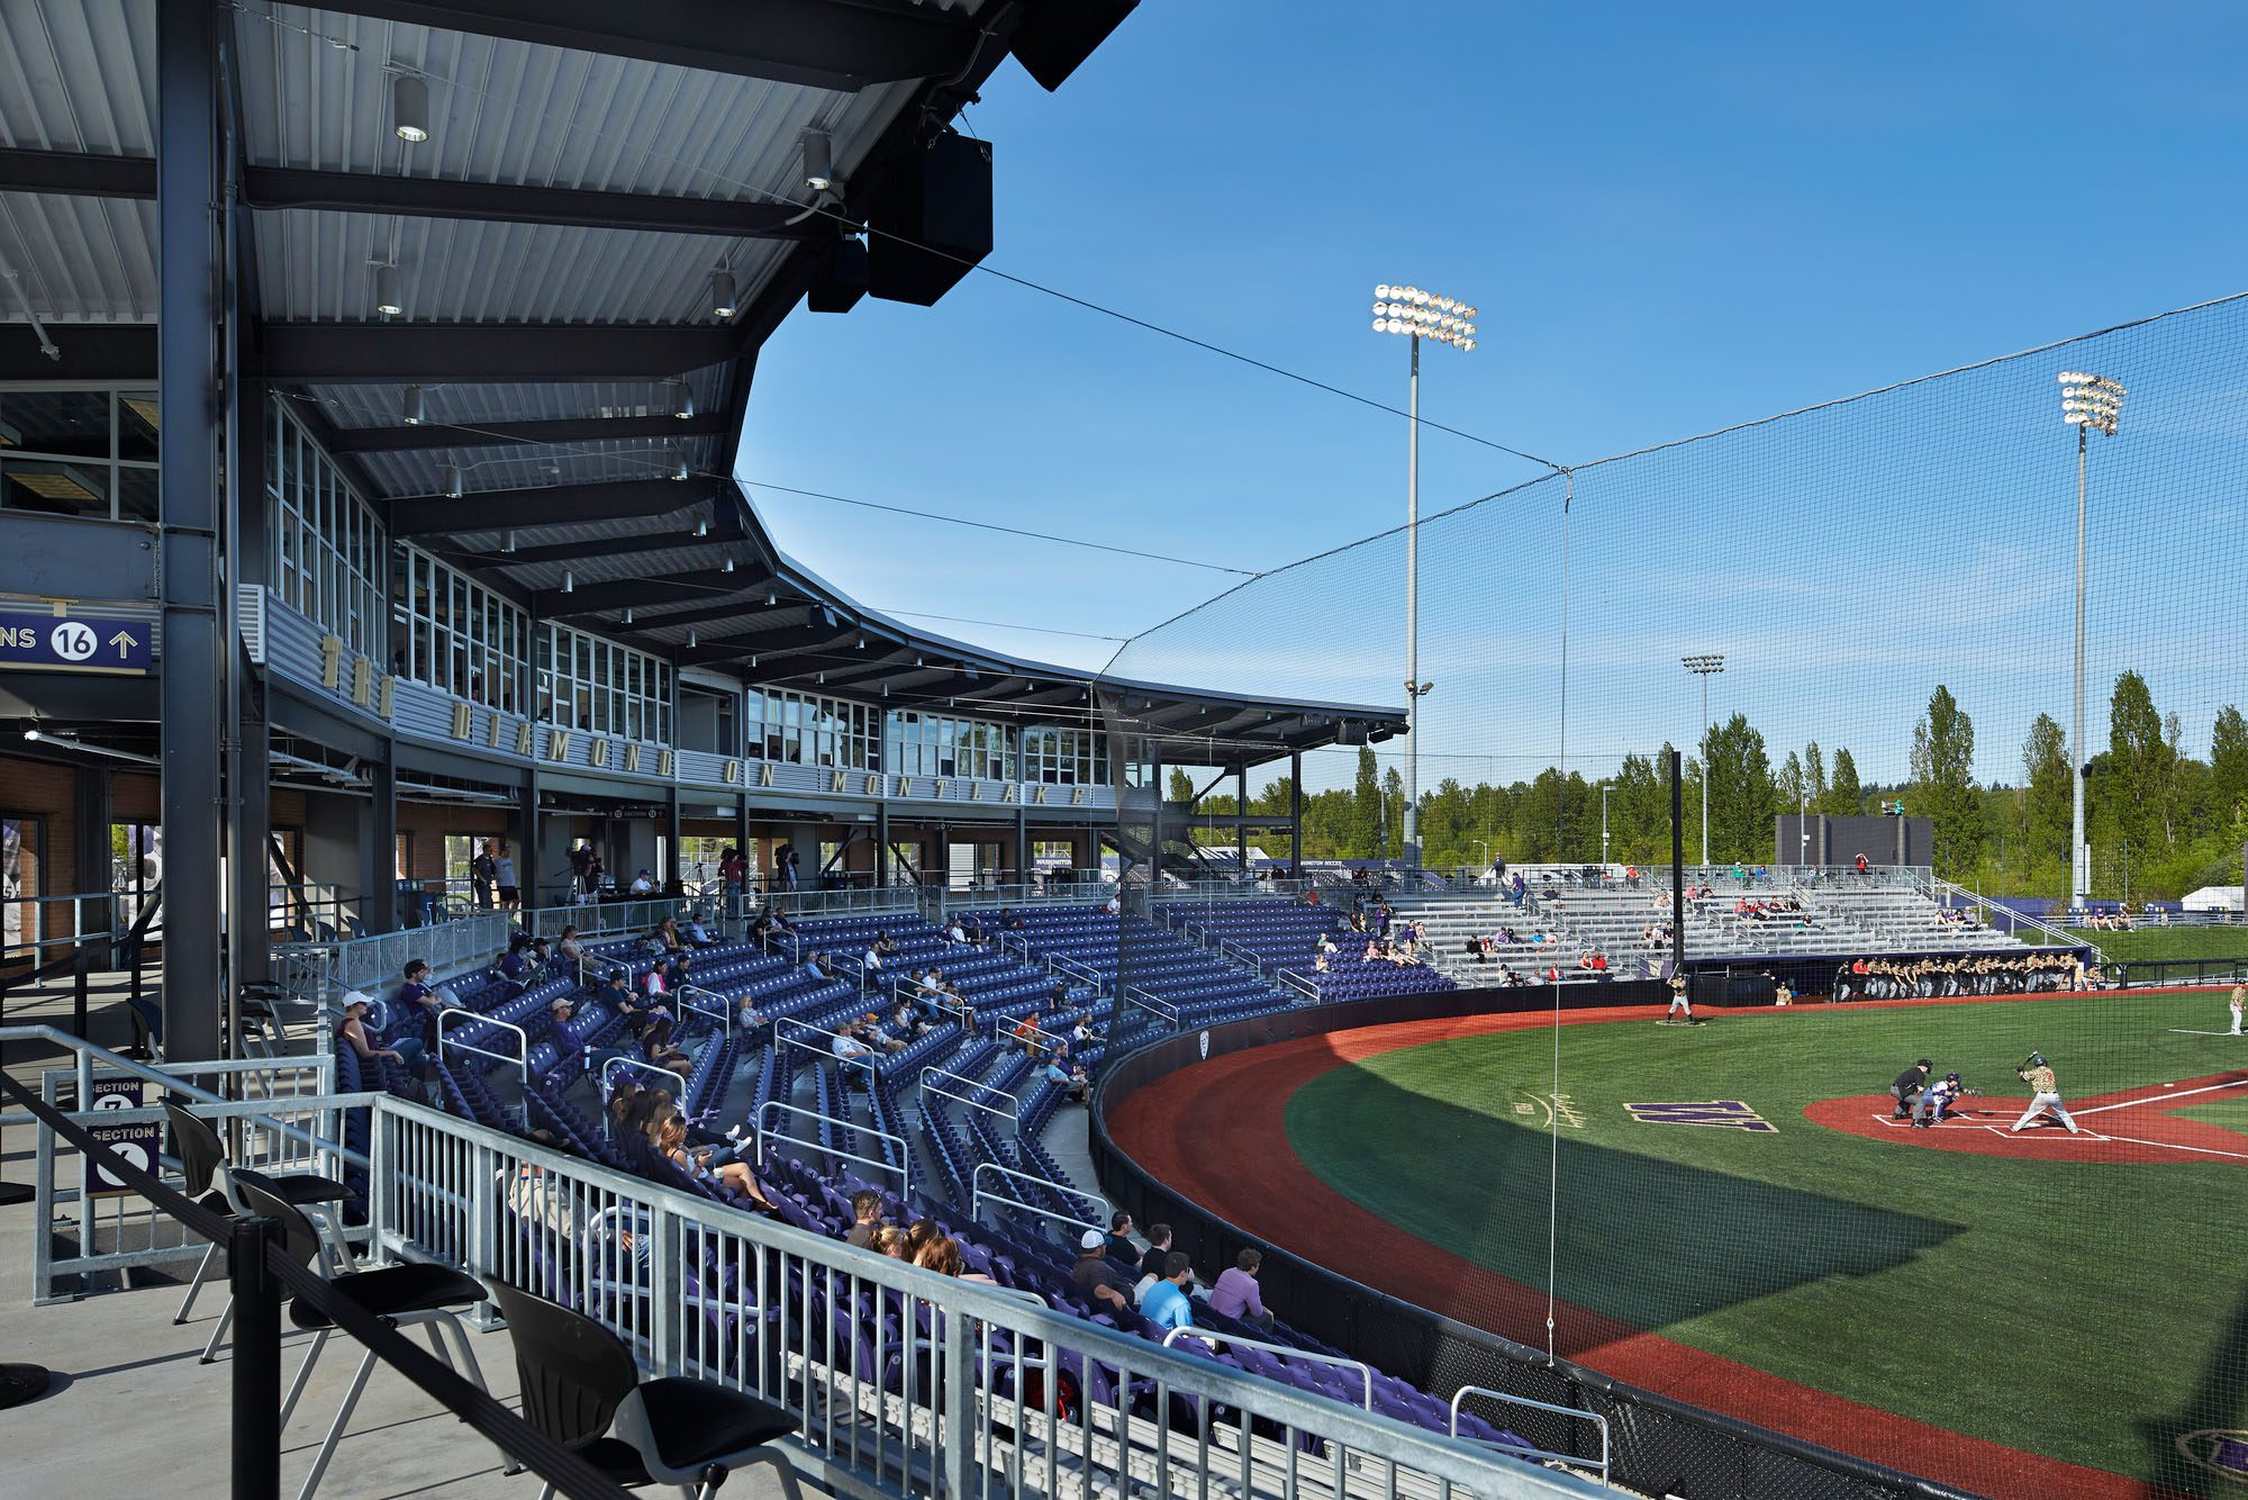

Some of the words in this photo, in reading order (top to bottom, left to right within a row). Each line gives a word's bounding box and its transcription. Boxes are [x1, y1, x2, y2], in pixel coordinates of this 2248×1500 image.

[57, 629, 91, 654] 16
[453, 702, 673, 777] DIAMOND
[724, 760, 775, 788] ON
[832, 771, 1085, 806] MONTLAKE
[92, 1081, 139, 1094] ECTION
[92, 1126, 155, 1141] SECTION
